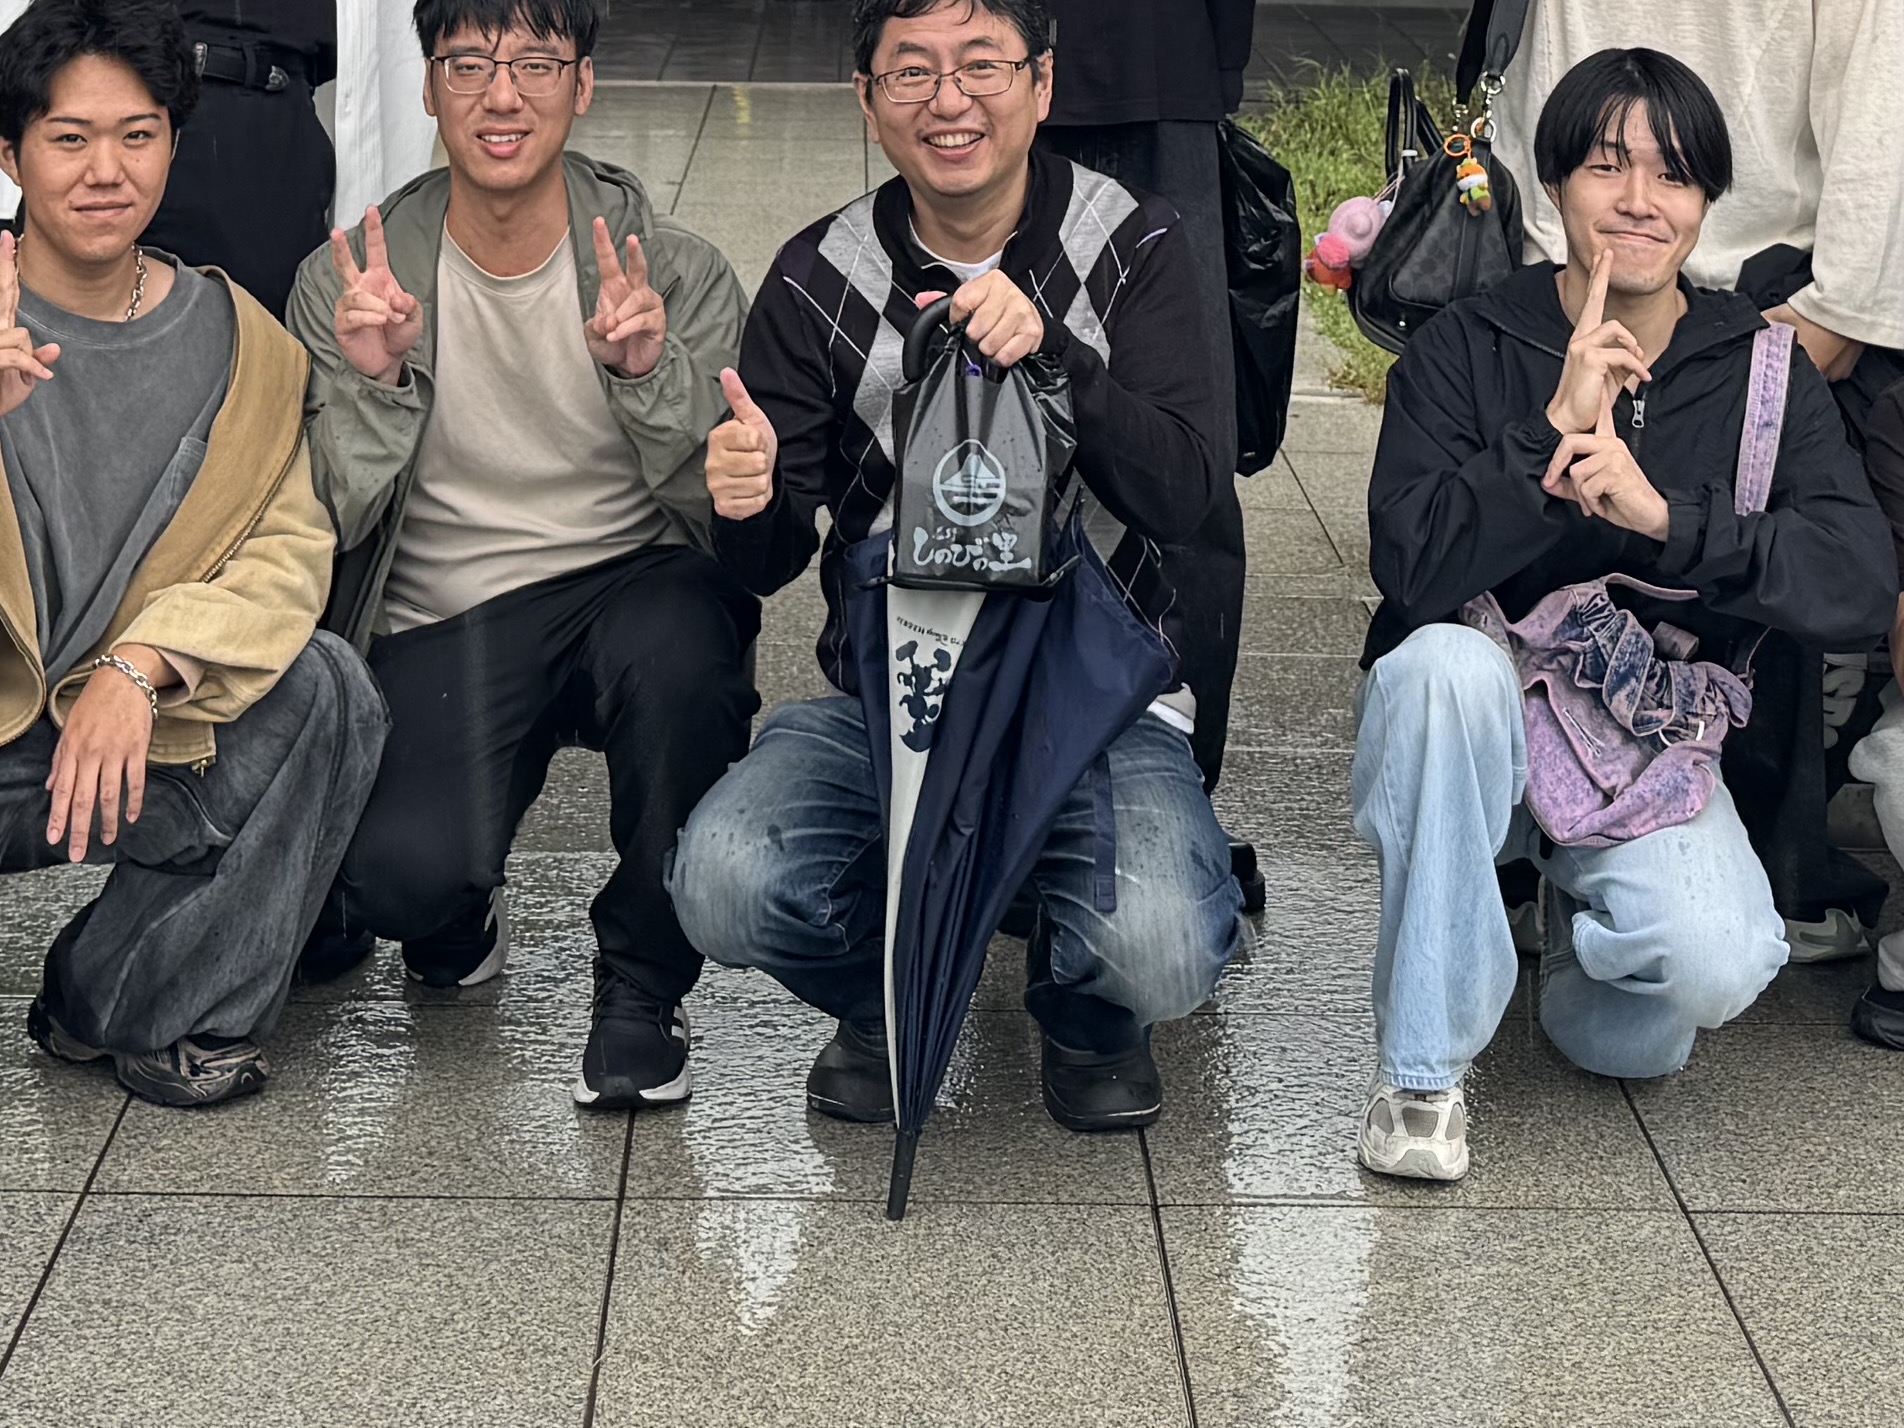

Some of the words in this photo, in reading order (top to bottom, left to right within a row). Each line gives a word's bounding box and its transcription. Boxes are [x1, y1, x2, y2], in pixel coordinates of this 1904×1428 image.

[913, 520, 1032, 572] しのびの里
